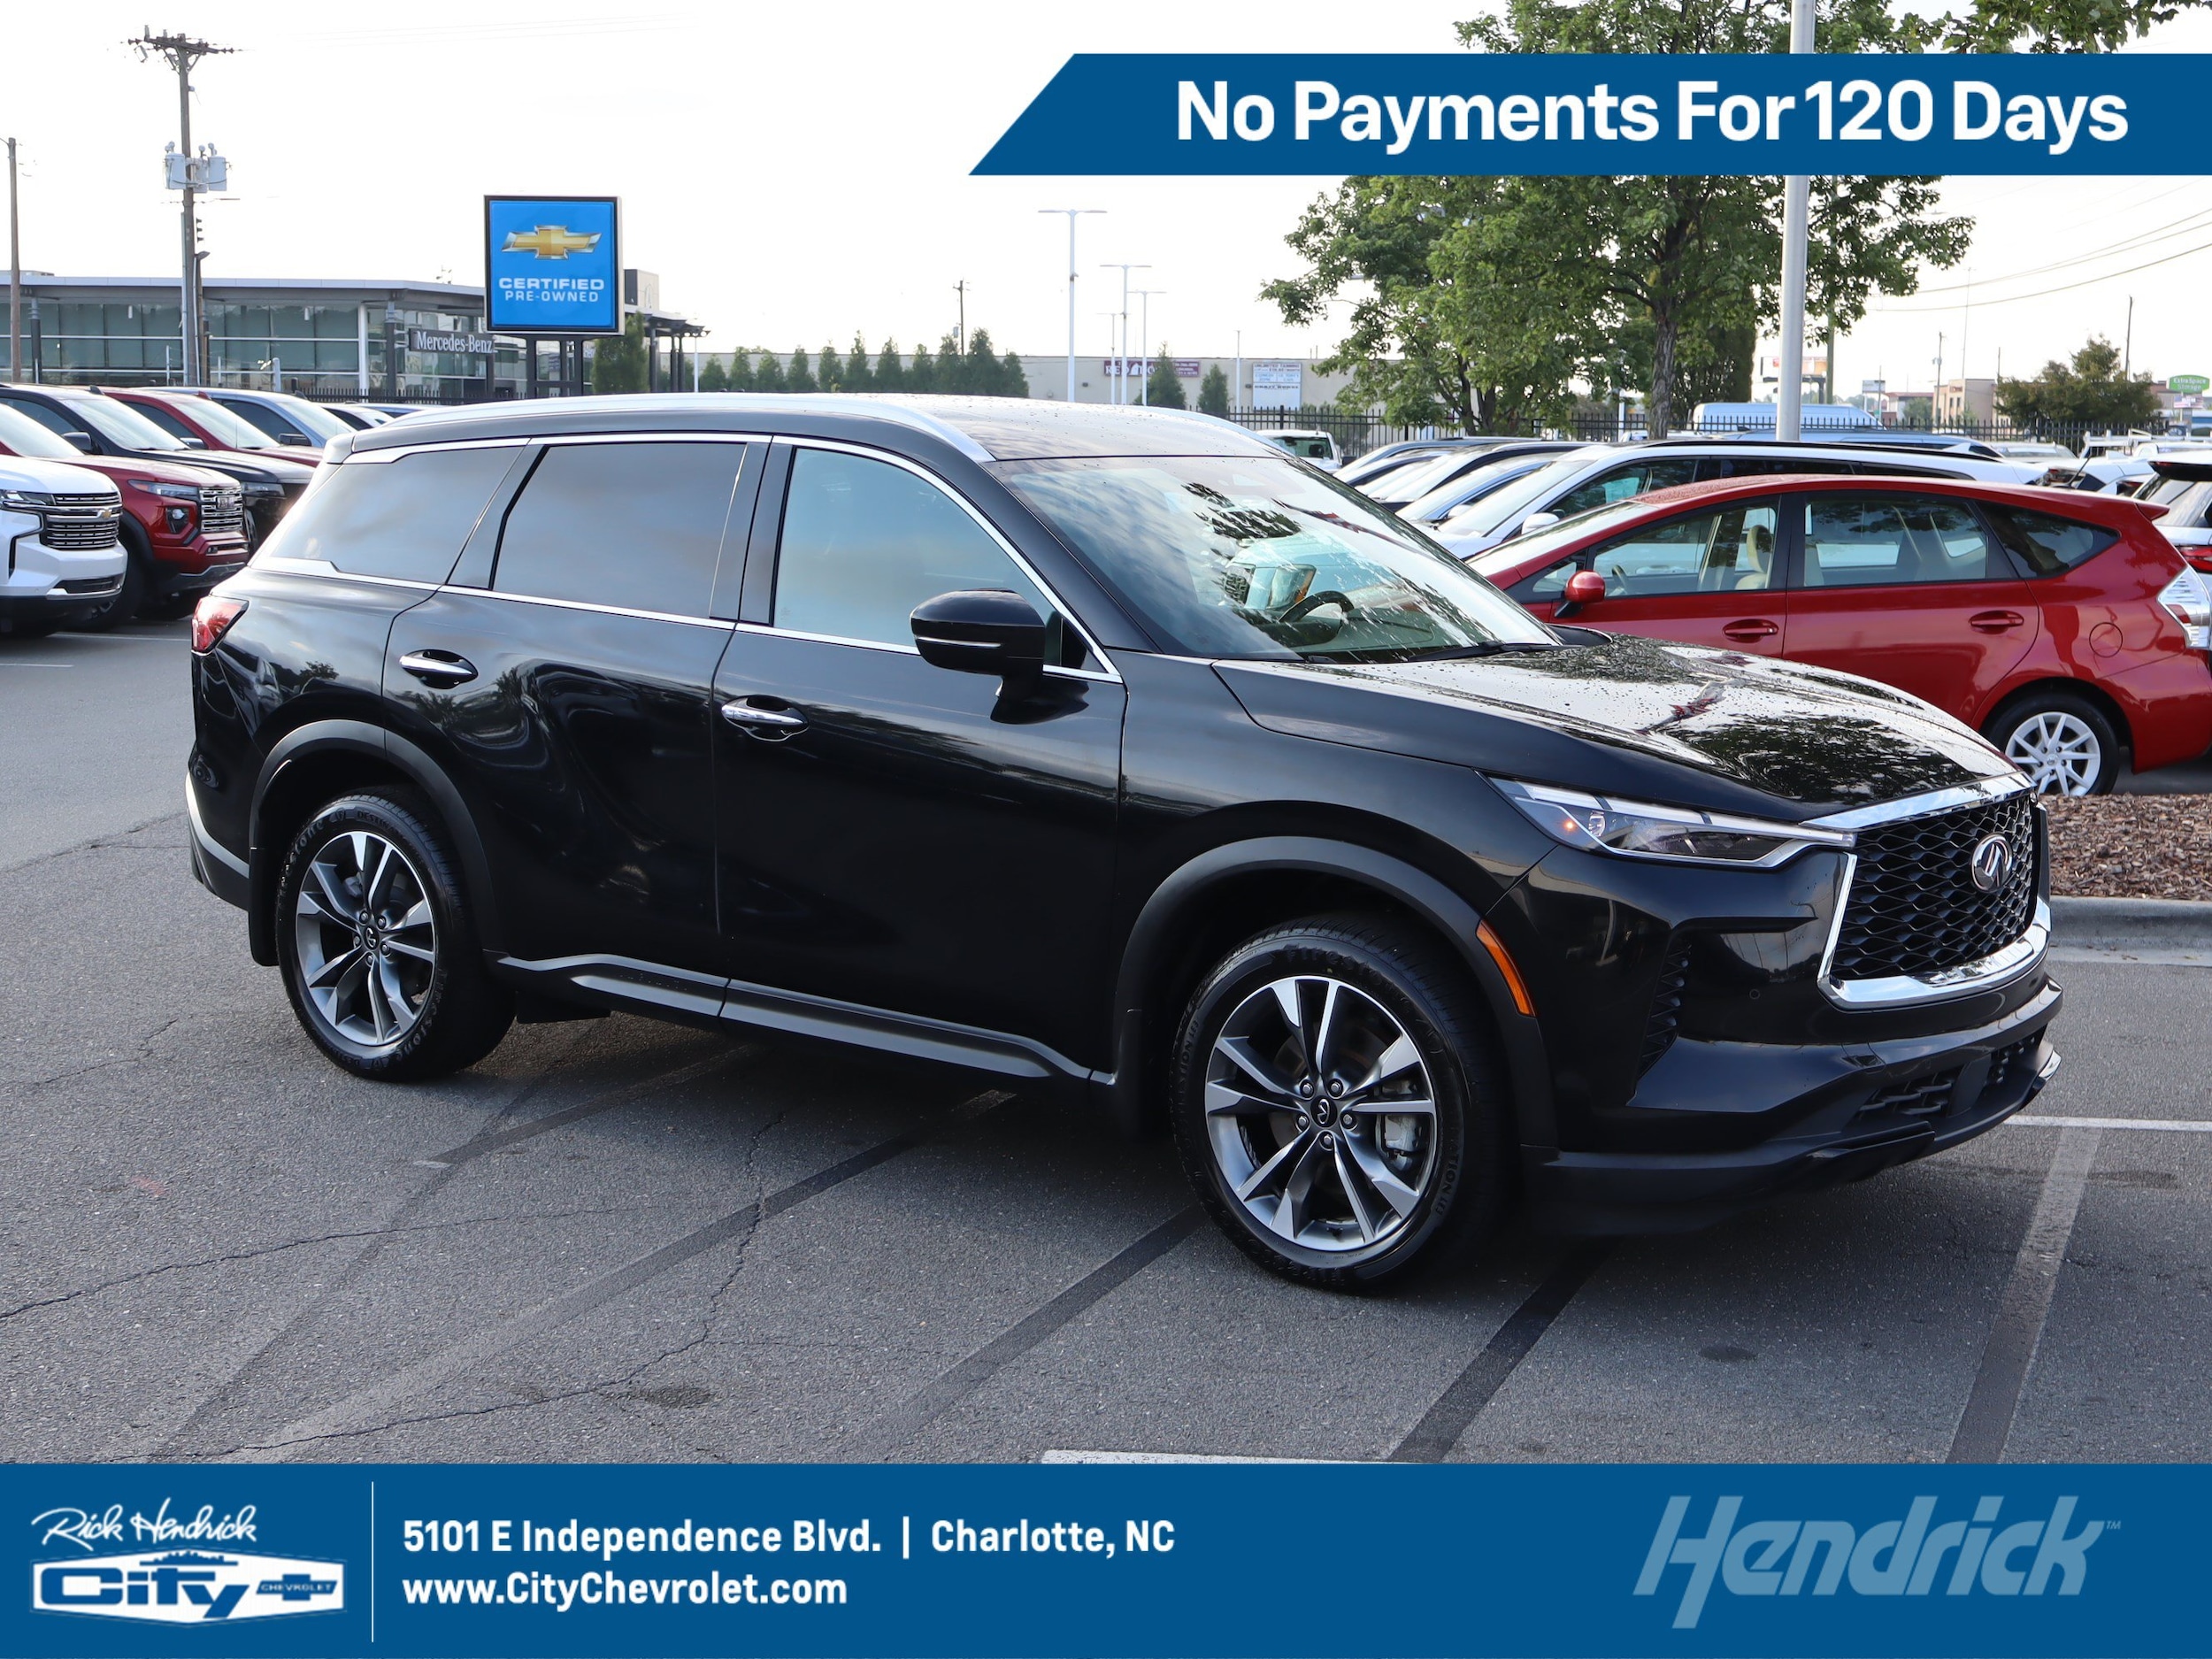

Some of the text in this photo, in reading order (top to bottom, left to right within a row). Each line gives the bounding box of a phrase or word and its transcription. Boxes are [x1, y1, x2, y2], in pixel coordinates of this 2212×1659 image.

[498, 277, 604, 289] CERTIFIED
[505, 290, 598, 302] PRE-OWNED
[417, 330, 492, 354] Mercedes-Benz
